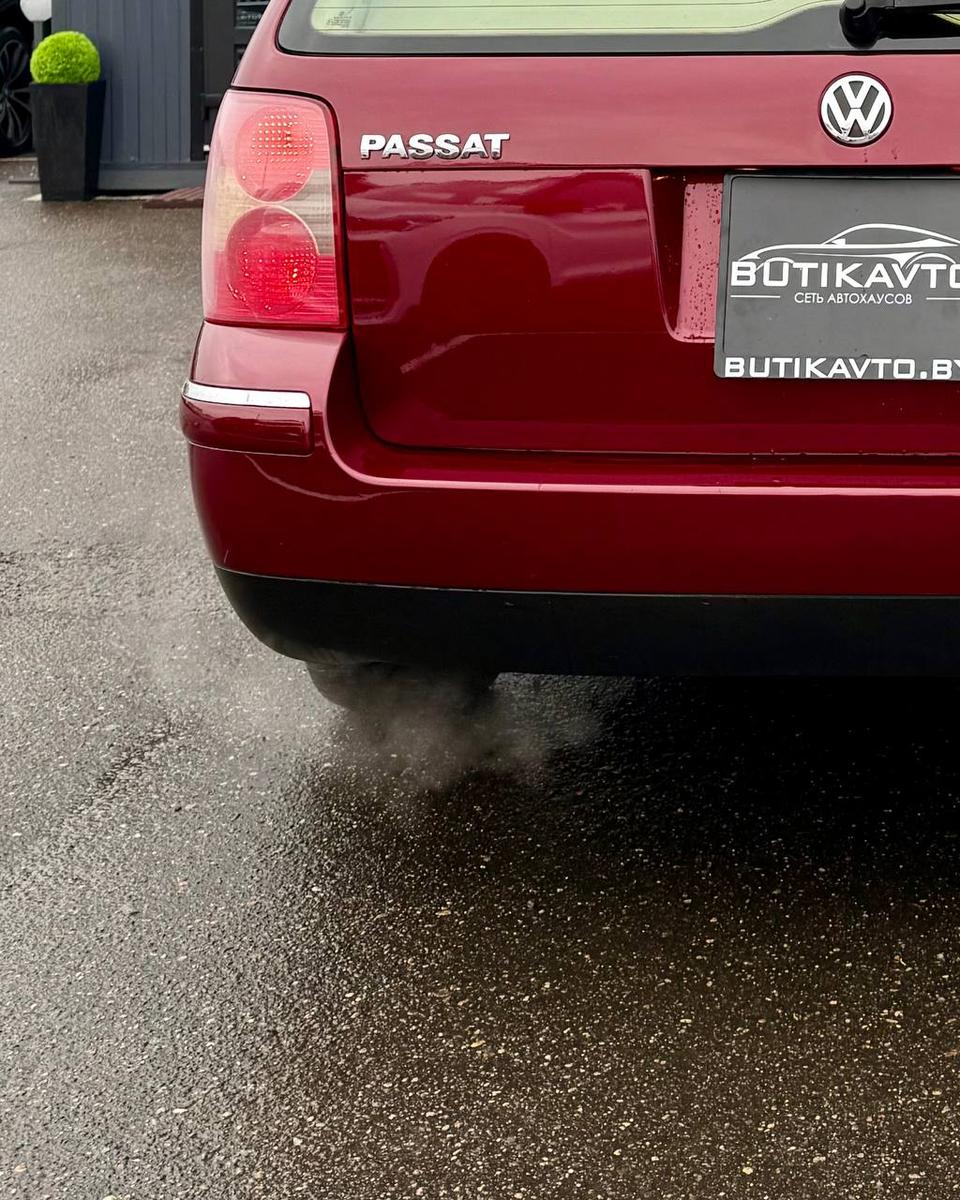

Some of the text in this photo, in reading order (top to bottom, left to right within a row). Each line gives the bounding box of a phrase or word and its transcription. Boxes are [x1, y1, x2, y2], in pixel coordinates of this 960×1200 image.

[820, 73, 893, 146] VW
[359, 132, 511, 160] PASSAT
[794, 292, 913, 305] СЕТЬ АВТОХАУСОВ
